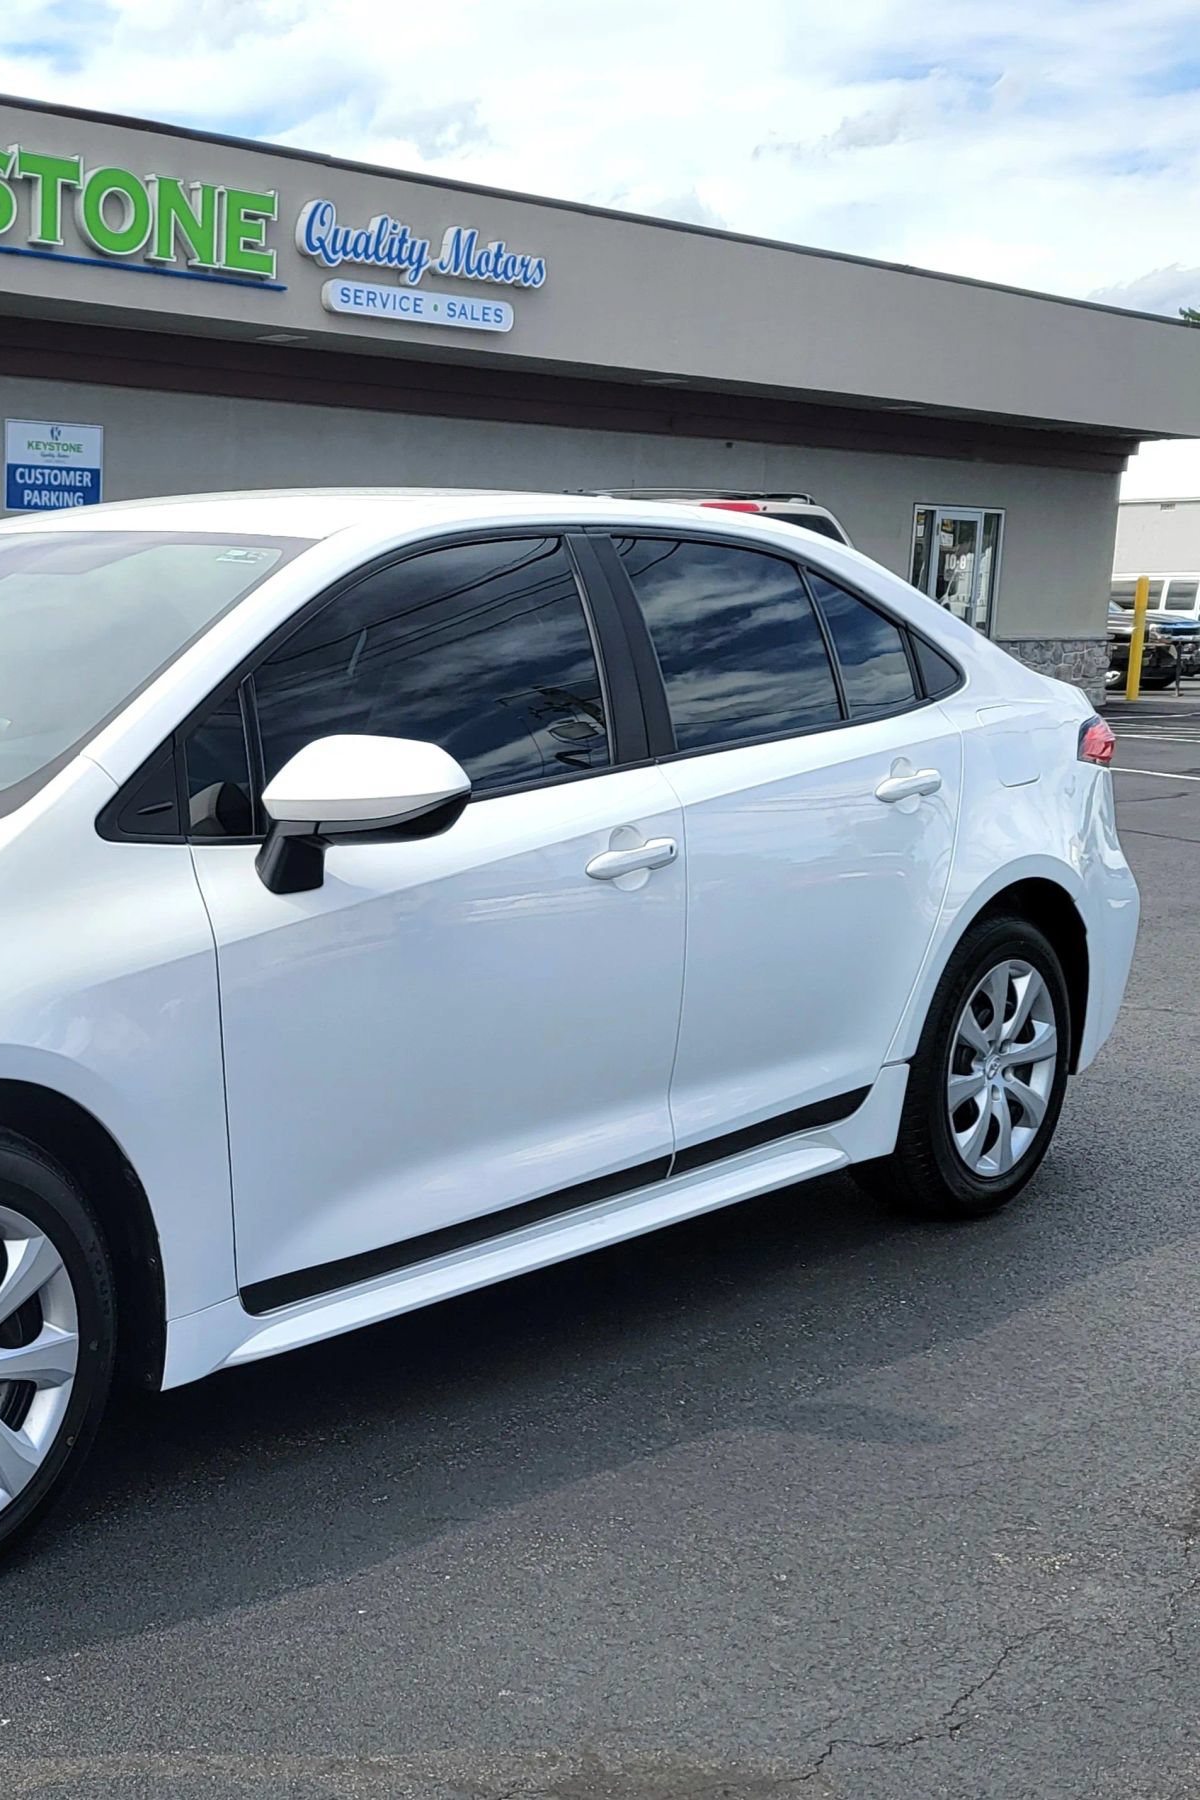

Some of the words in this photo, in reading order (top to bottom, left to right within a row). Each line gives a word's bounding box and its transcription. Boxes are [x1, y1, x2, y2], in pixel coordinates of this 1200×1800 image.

[302, 199, 430, 284] Quality
[437, 226, 547, 288] Motors
[340, 287, 424, 314] SERVICE
[446, 301, 504, 323] SALES
[27, 440, 84, 454] KEYSTONE
[15, 467, 92, 487] CUSTOMER
[23, 489, 84, 507] PARKING
